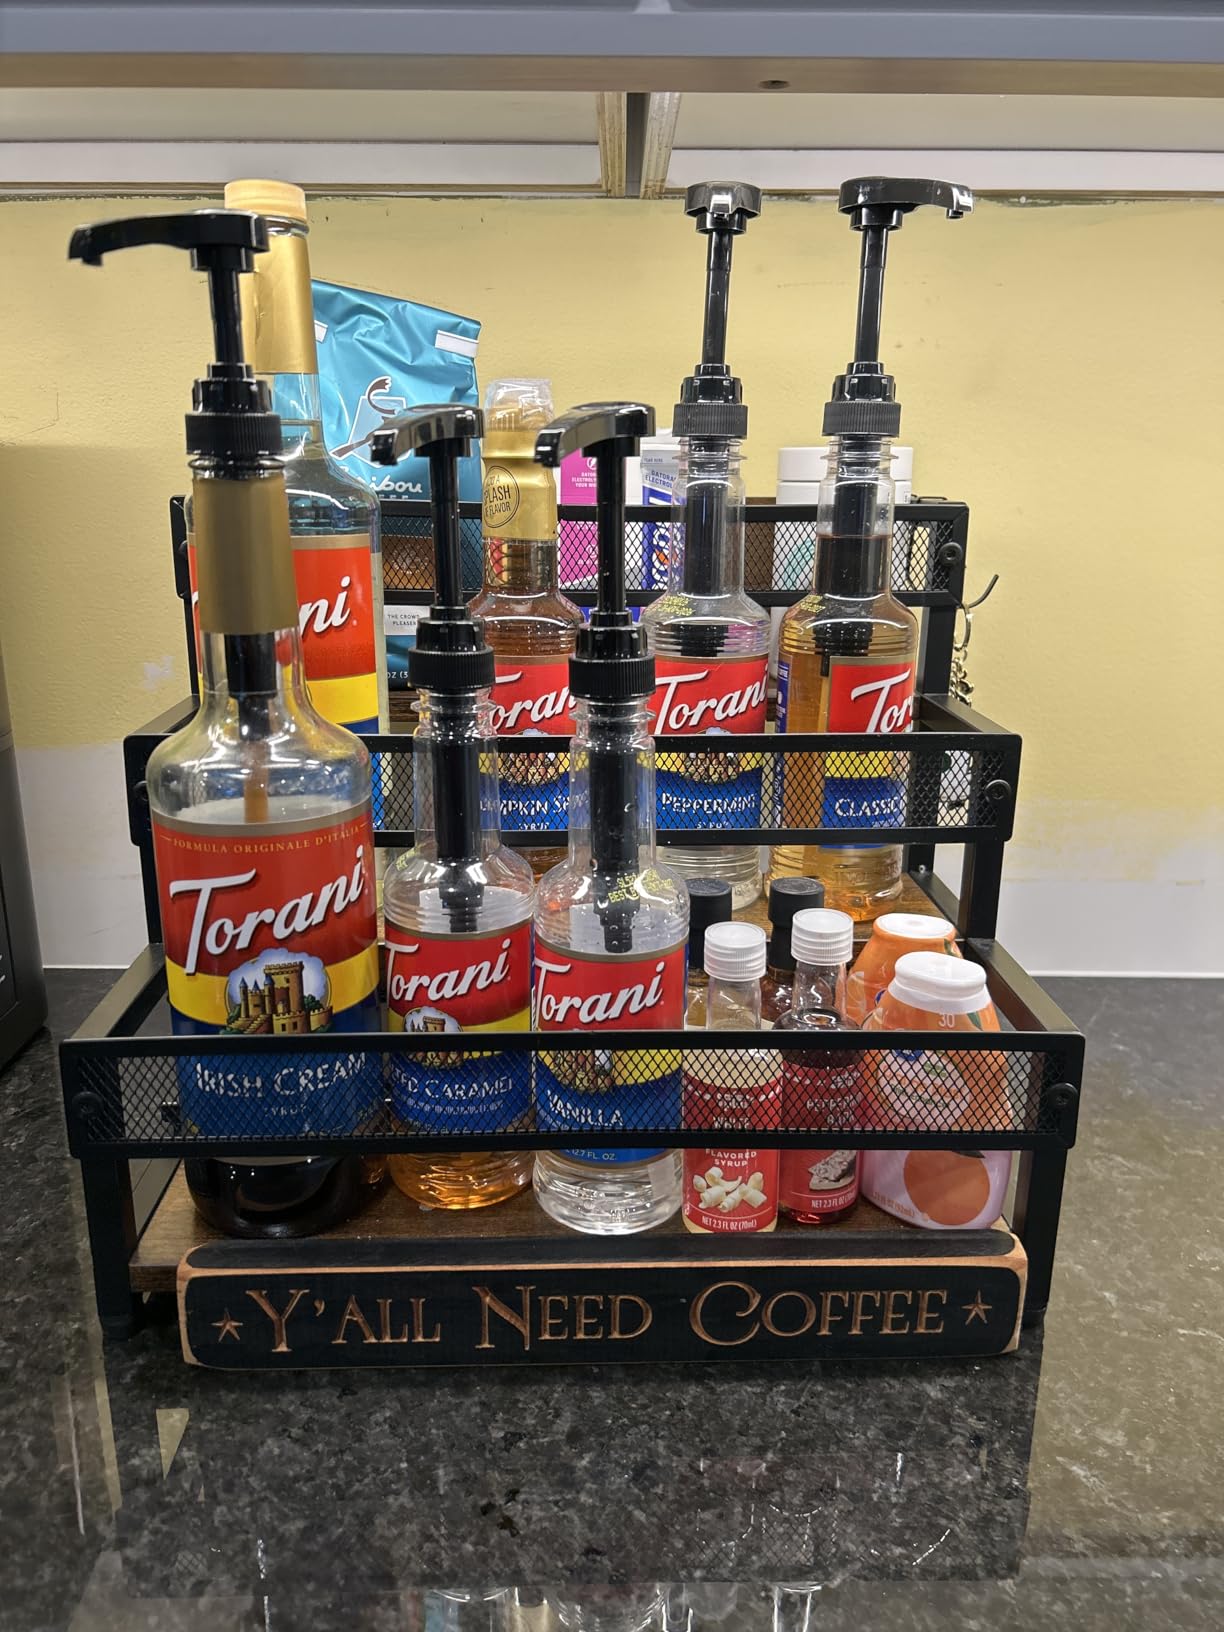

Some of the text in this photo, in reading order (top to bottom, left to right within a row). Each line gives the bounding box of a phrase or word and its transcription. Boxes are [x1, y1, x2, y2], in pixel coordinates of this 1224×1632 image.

[484, 484, 512, 507] PLASH
[173, 826, 361, 854] FORMULA ORIGINALE D'ITALIA
[169, 844, 365, 977] Torani
[385, 938, 512, 1001] Torani
[535, 961, 665, 1026] Torani
[938, 1013, 956, 1029] 30
[273, 1052, 366, 1096] CREAM
[425, 1076, 513, 1100] CARAMEL
[547, 1089, 624, 1127] VANILLA
[706, 1148, 757, 1160] FLAVORED
[714, 1159, 749, 1167] SYRUP
[811, 1199, 822, 1209] NET
[702, 1216, 712, 1227] NET
[712, 1218, 722, 1229] 2.3
[245, 1281, 948, 1353] Y'ALL NEED COFFEE
